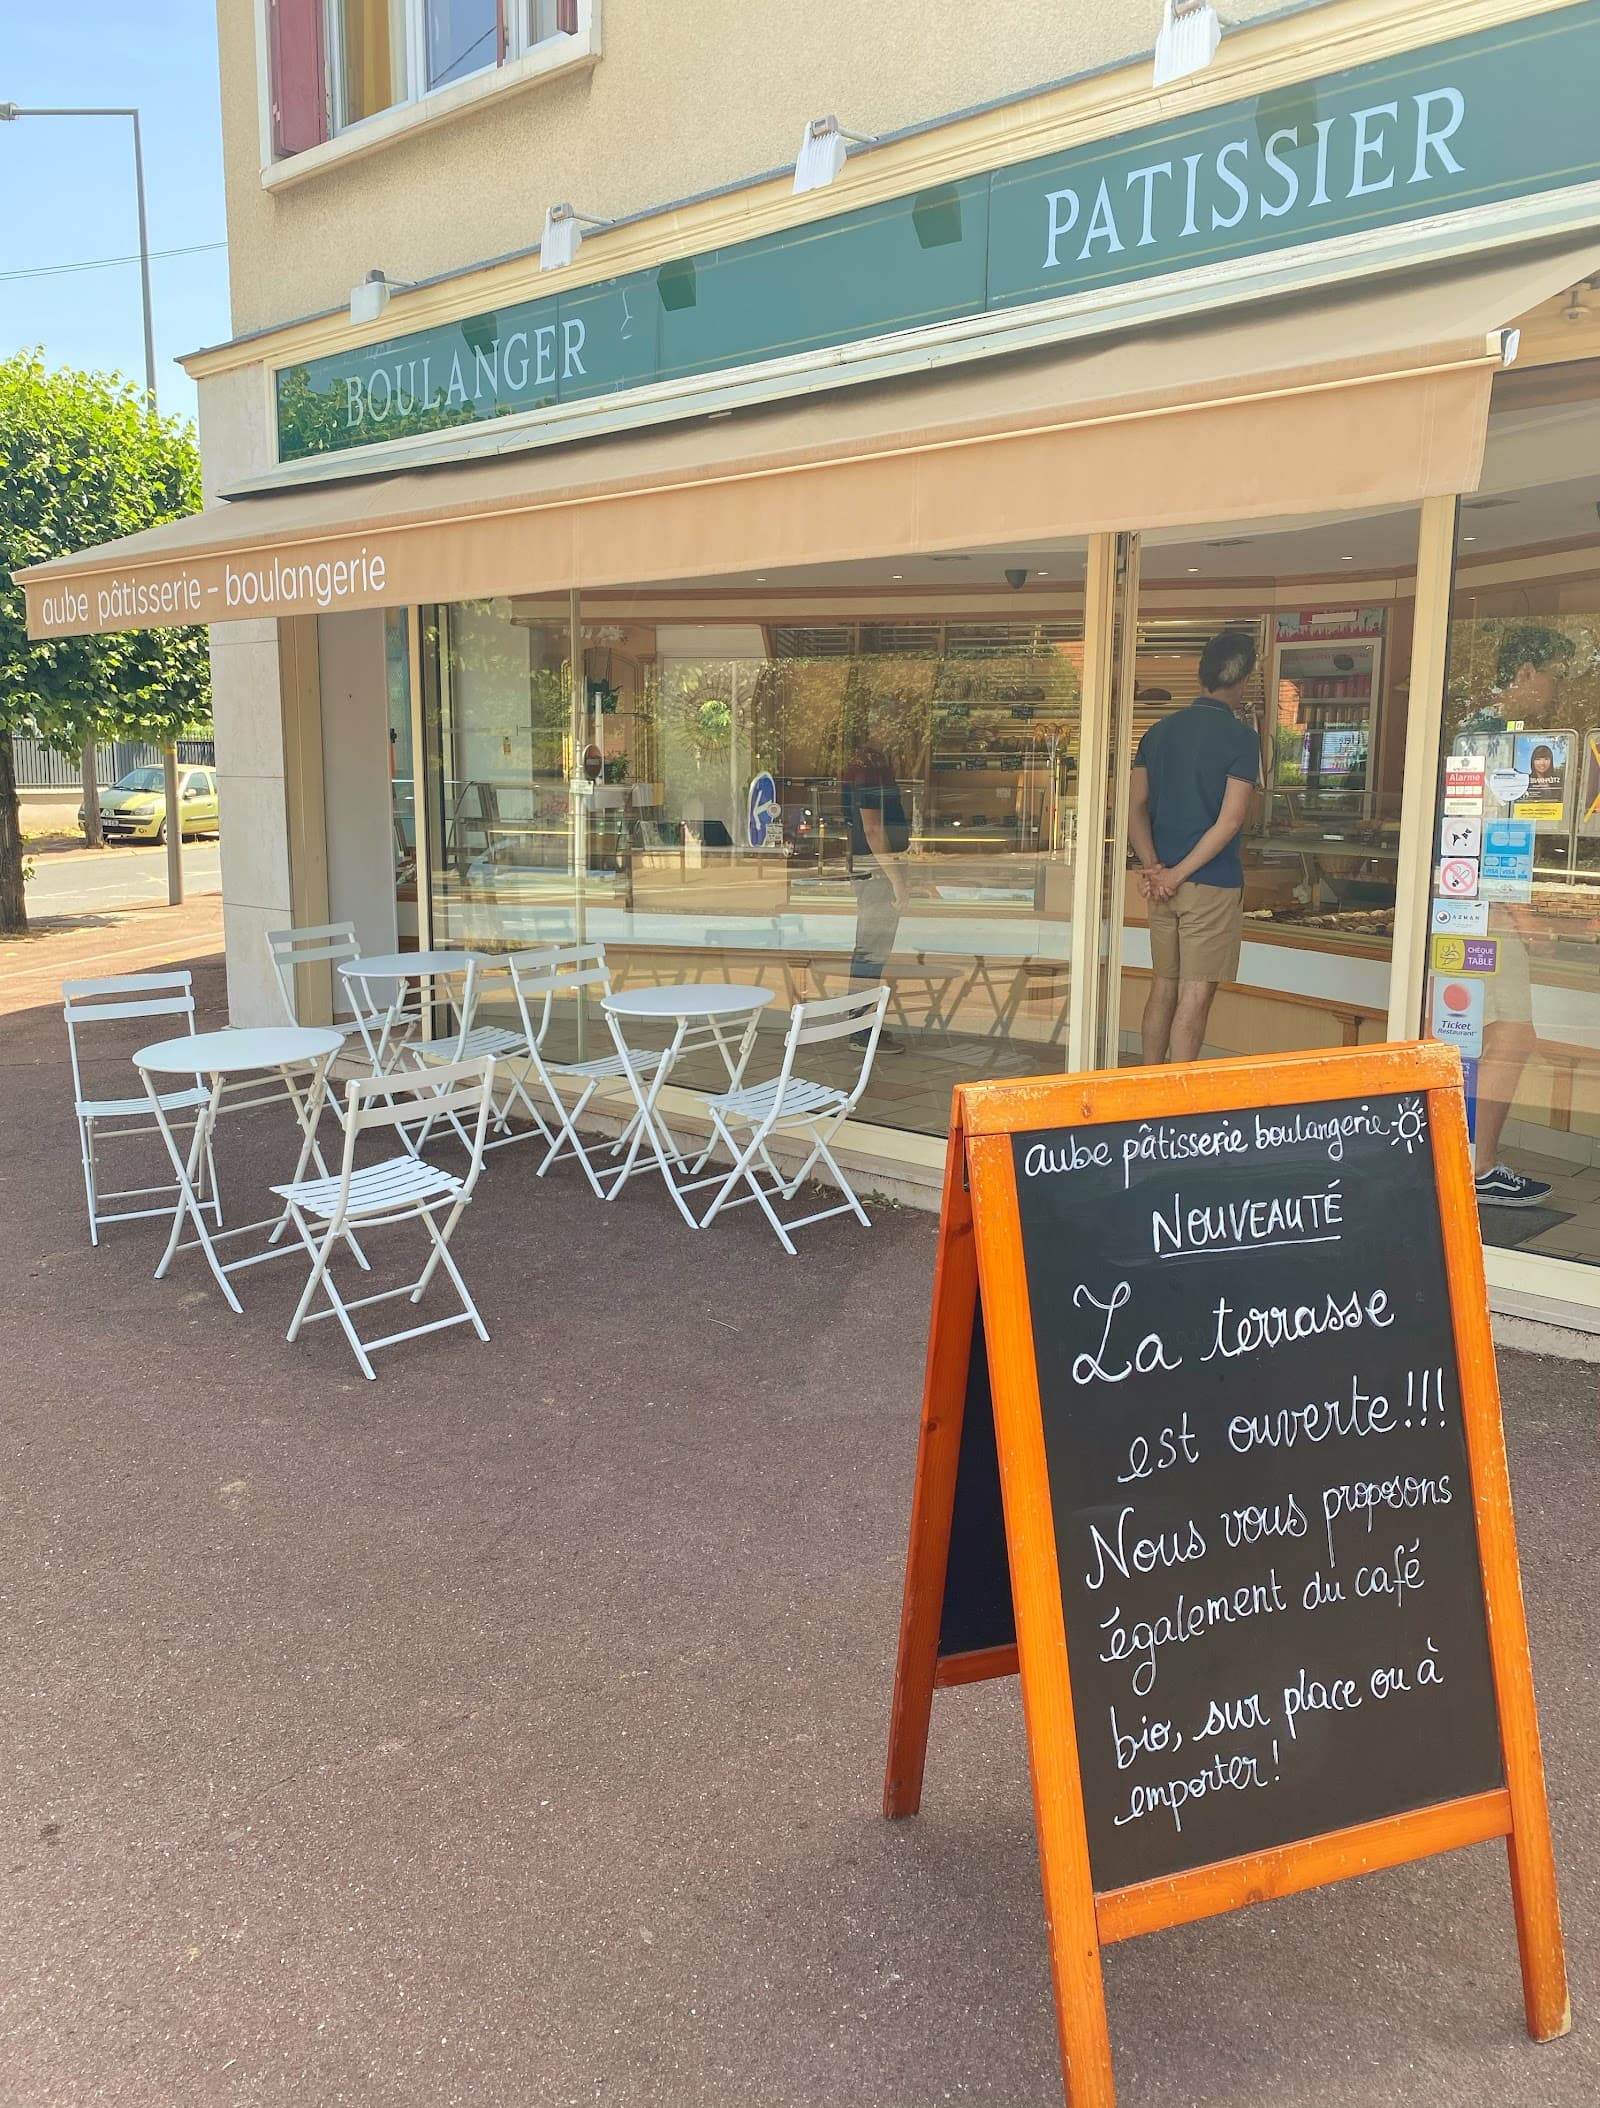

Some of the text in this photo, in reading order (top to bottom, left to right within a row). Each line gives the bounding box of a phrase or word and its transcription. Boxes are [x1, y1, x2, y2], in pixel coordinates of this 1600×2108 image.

[1041, 86, 1466, 268] PATISSIER
[346, 318, 588, 428] BOULANGER
[42, 586, 89, 625] aube
[98, 571, 201, 626] pâtisserie
[225, 547, 386, 607] boulangerie
[1449, 773, 1481, 782] Alarme
[1467, 957, 1495, 966] TABLE
[1441, 1020, 1472, 1031] Ticket
[1024, 1104, 1390, 1189] aube pâtisserie boulangerie
[1152, 1179, 1342, 1253] NOUVEAUTÉ
[1072, 1280, 1395, 1385] La terrasse
[1117, 1412, 1199, 1483] est
[1086, 1475, 1453, 1589] Nous vous proposons
[1100, 1537, 1425, 1696] également du café
[1111, 1637, 1443, 1769] bio, sur place ou à
